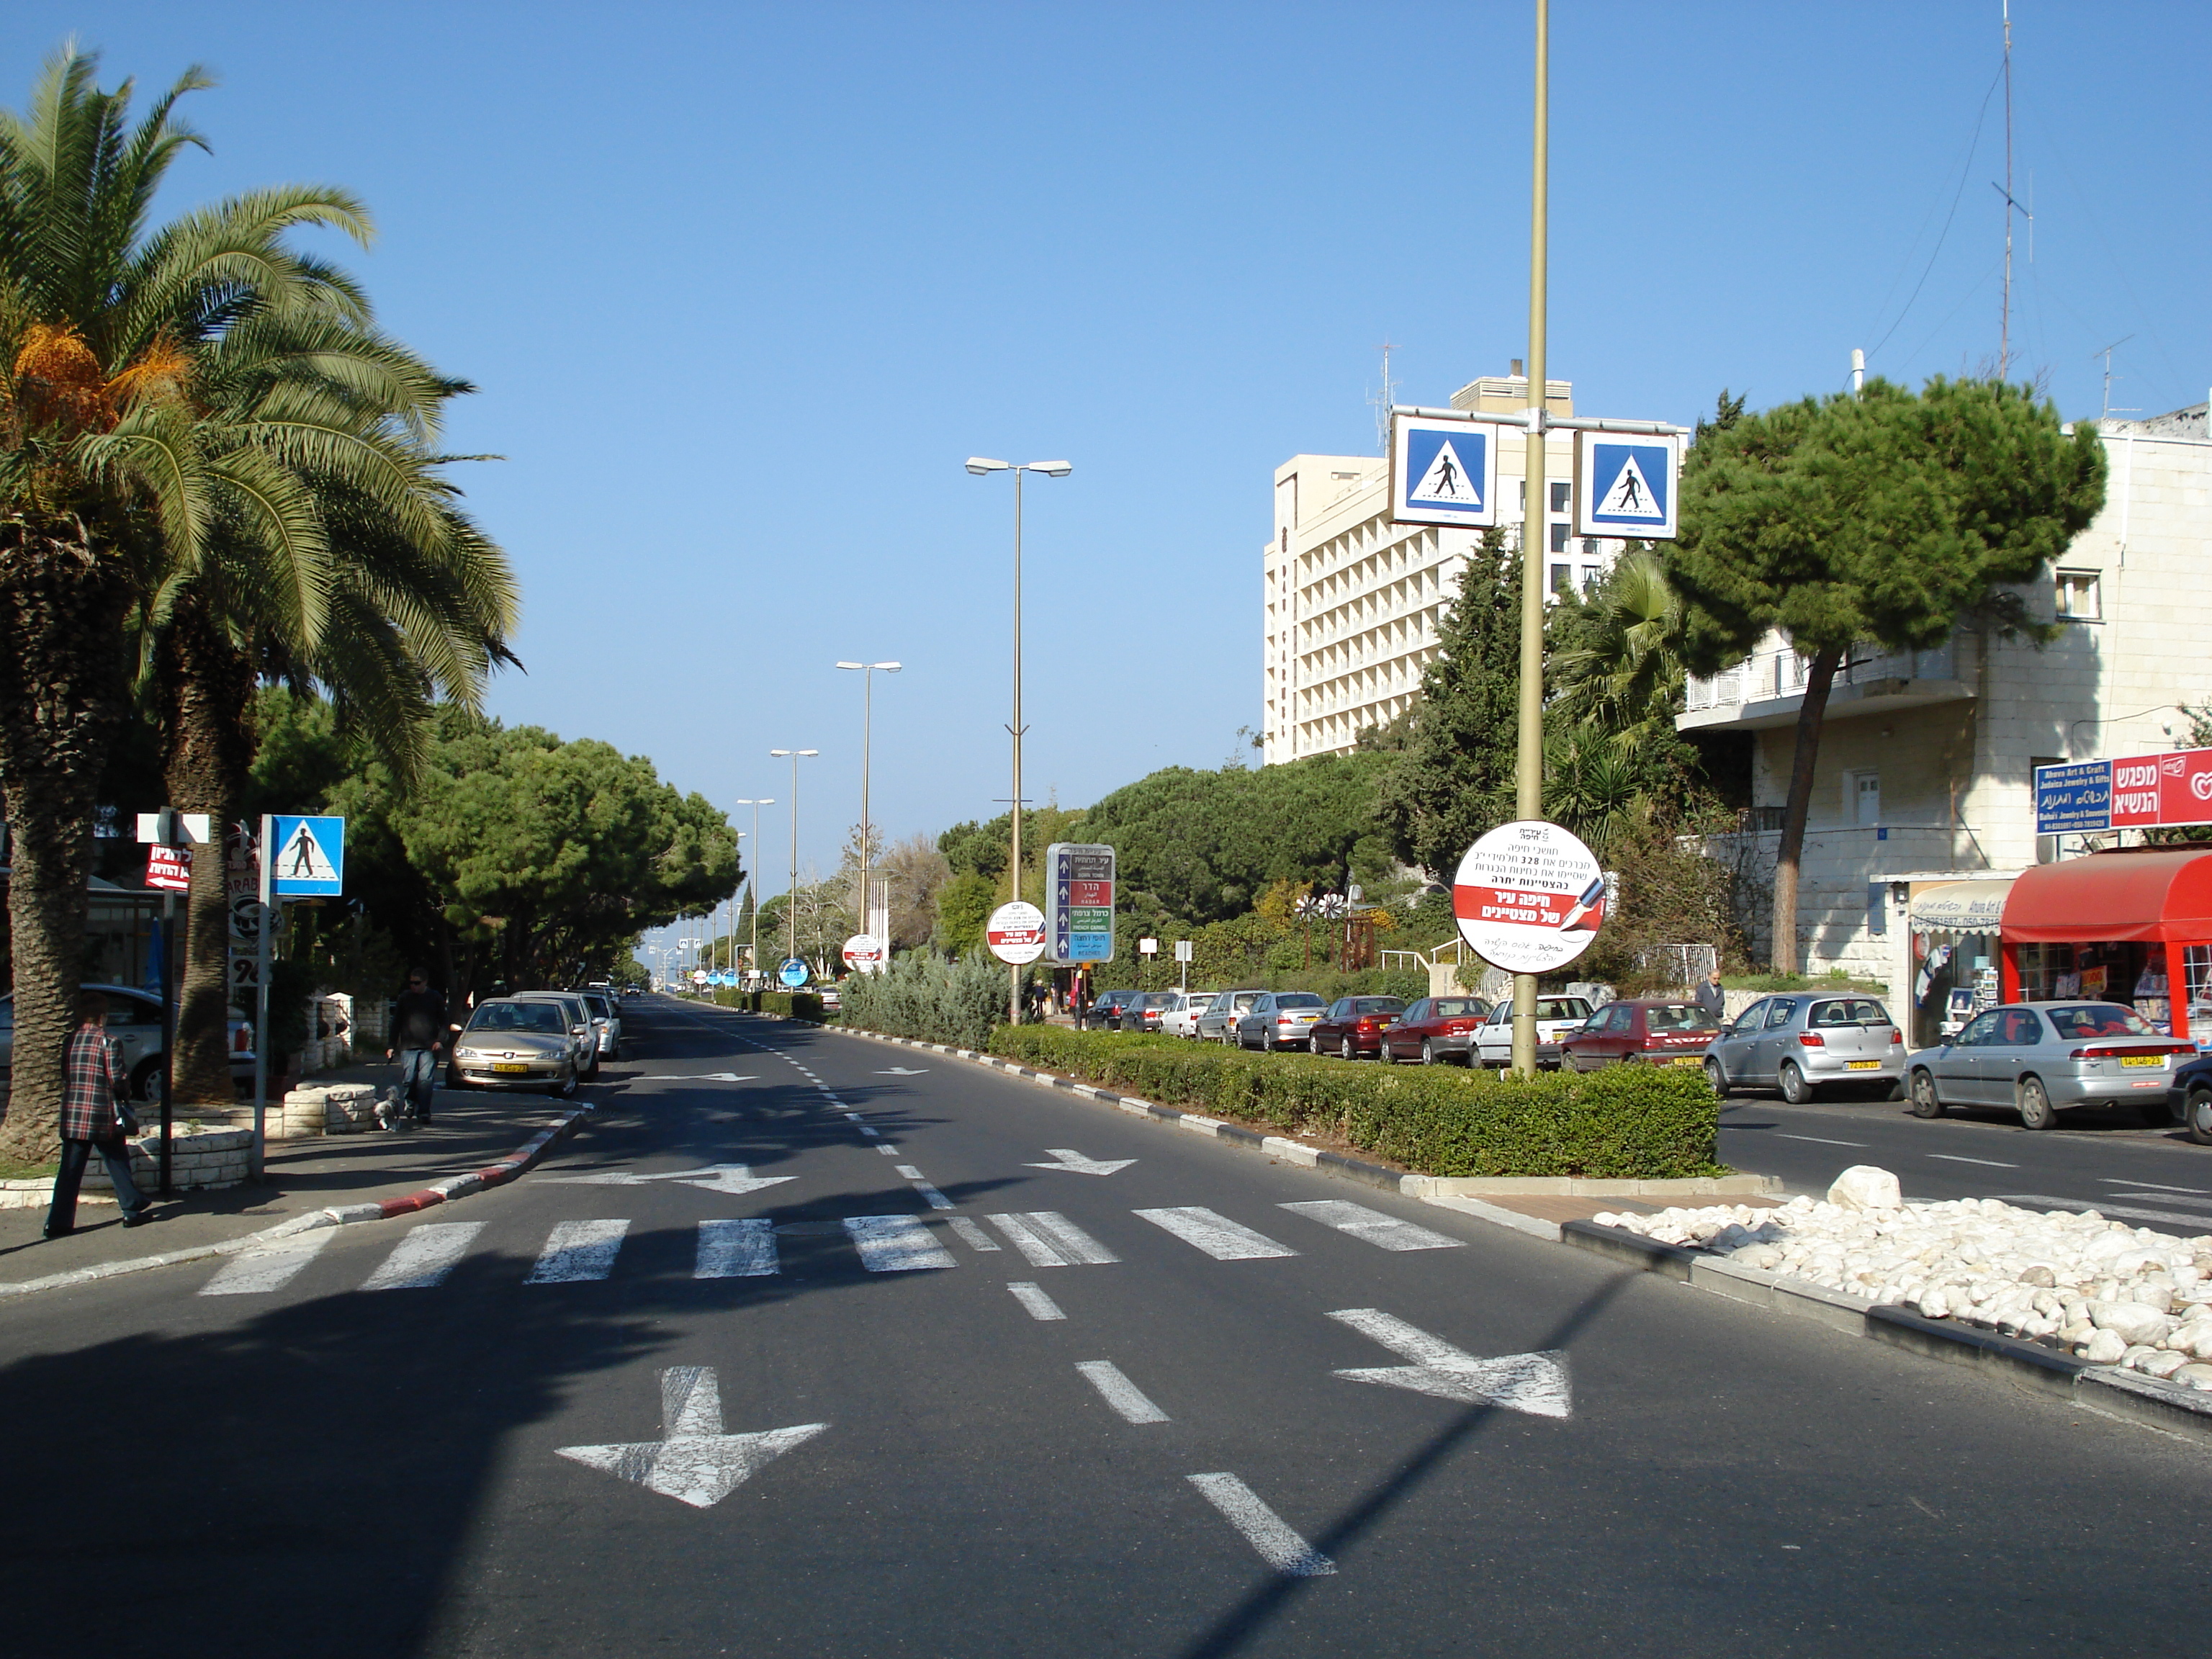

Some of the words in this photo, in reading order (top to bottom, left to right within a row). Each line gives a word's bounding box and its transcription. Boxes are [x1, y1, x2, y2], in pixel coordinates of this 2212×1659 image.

[2067, 768, 2077, 776] Art
[2079, 767, 2085, 775] &
[2087, 765, 2105, 774] Craft
[2064, 778, 2088, 786] Jewelry
[2089, 776, 2094, 785] &
[2095, 775, 2110, 783] Gifts
[2117, 765, 2157, 788] מפגש
[2114, 791, 2158, 814] הנשיא
[1508, 843, 1530, 853] חיפה
[1533, 846, 1558, 855] תושבי
[150, 846, 193, 863] לחניון
[1488, 853, 1518, 863] תלמידי
[1521, 856, 1539, 865] 328
[1543, 858, 1556, 866] את
[1559, 859, 1591, 870] מברכים
[148, 862, 179, 877] החיות
[1475, 863, 1506, 873] הבגרות
[1509, 866, 1537, 876] בחינות
[1541, 869, 1554, 878] את
[1491, 876, 1515, 884] יתרה
[1557, 871, 1587, 881] שסיימו
[227, 877, 258, 894] ARAB
[1519, 878, 1569, 890] בהצטיינות
[1494, 891, 1516, 904] עיר
[1518, 893, 1551, 908] חיפה
[1986, 900, 1996, 913] Art
[1481, 905, 1537, 922] מצטיינים
[1540, 908, 1561, 924] של
